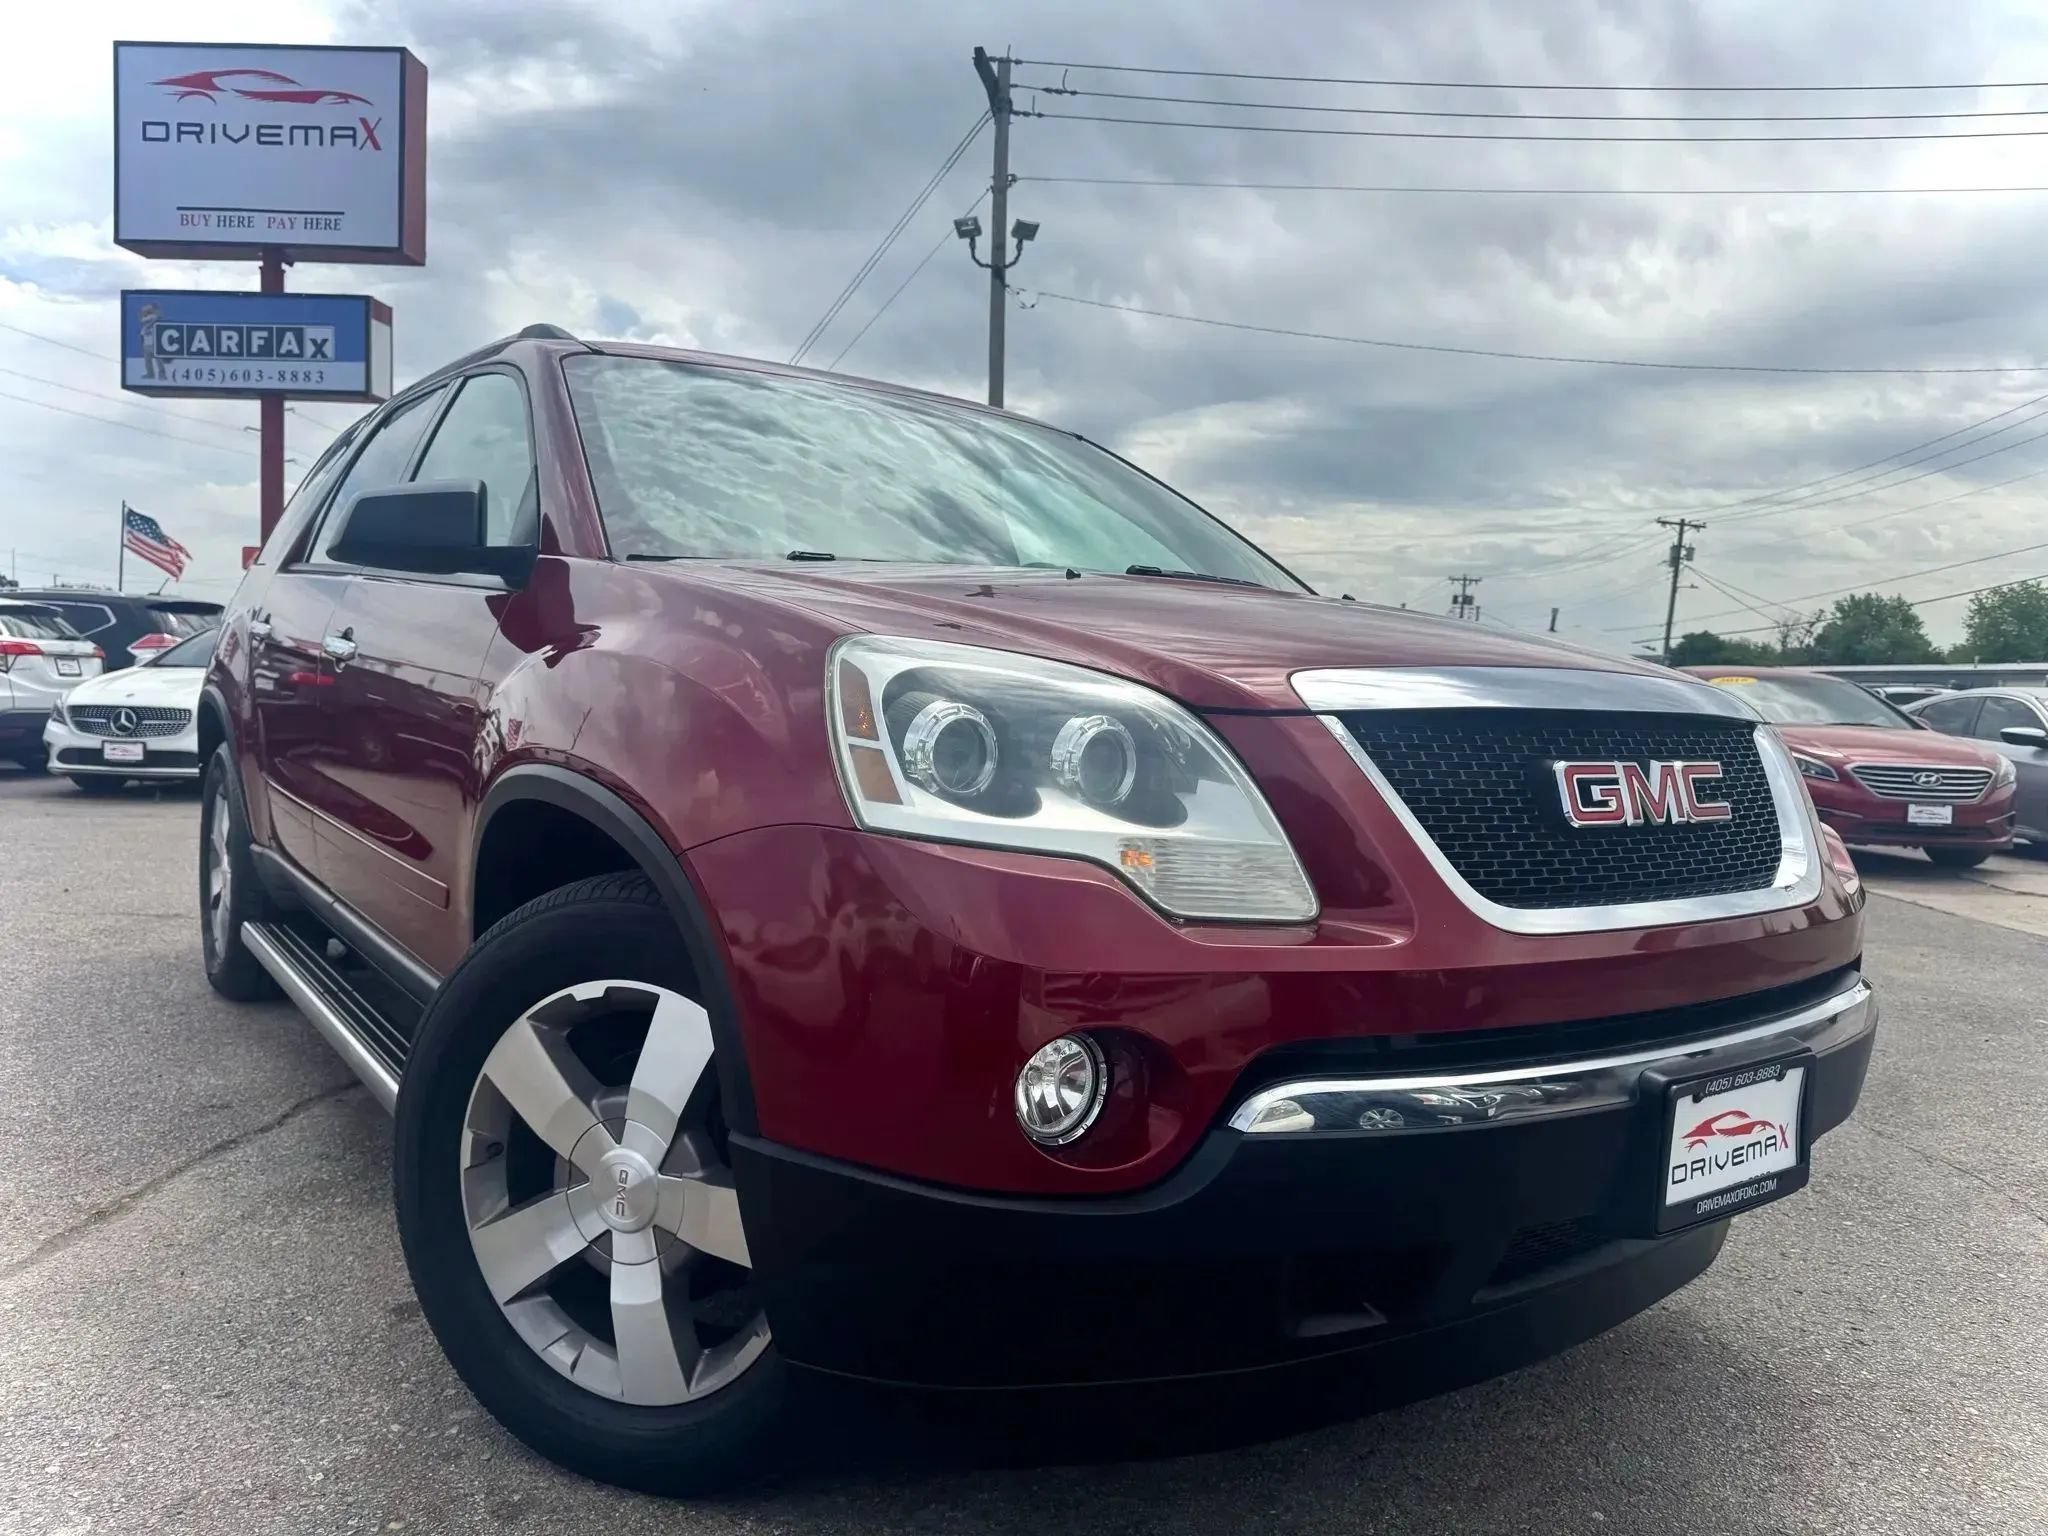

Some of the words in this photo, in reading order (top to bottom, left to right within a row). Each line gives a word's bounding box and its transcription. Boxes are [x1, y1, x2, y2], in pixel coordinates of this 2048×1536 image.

[142, 117, 382, 150] DRIVEMAX
[179, 213, 211, 227] BUY
[216, 215, 255, 229] HERE
[267, 216, 297, 230] PAY
[303, 217, 341, 231] HERE
[160, 328, 329, 359] CARFAX
[171, 368, 325, 384] (405)603-8883
[1553, 760, 1732, 828] GMC
[1706, 1078, 1732, 1093] (405)
[1735, 1065, 1780, 1086] 603-8883
[1671, 1123, 1789, 1185] DRIVEMAX
[616, 1169, 629, 1217] GMC
